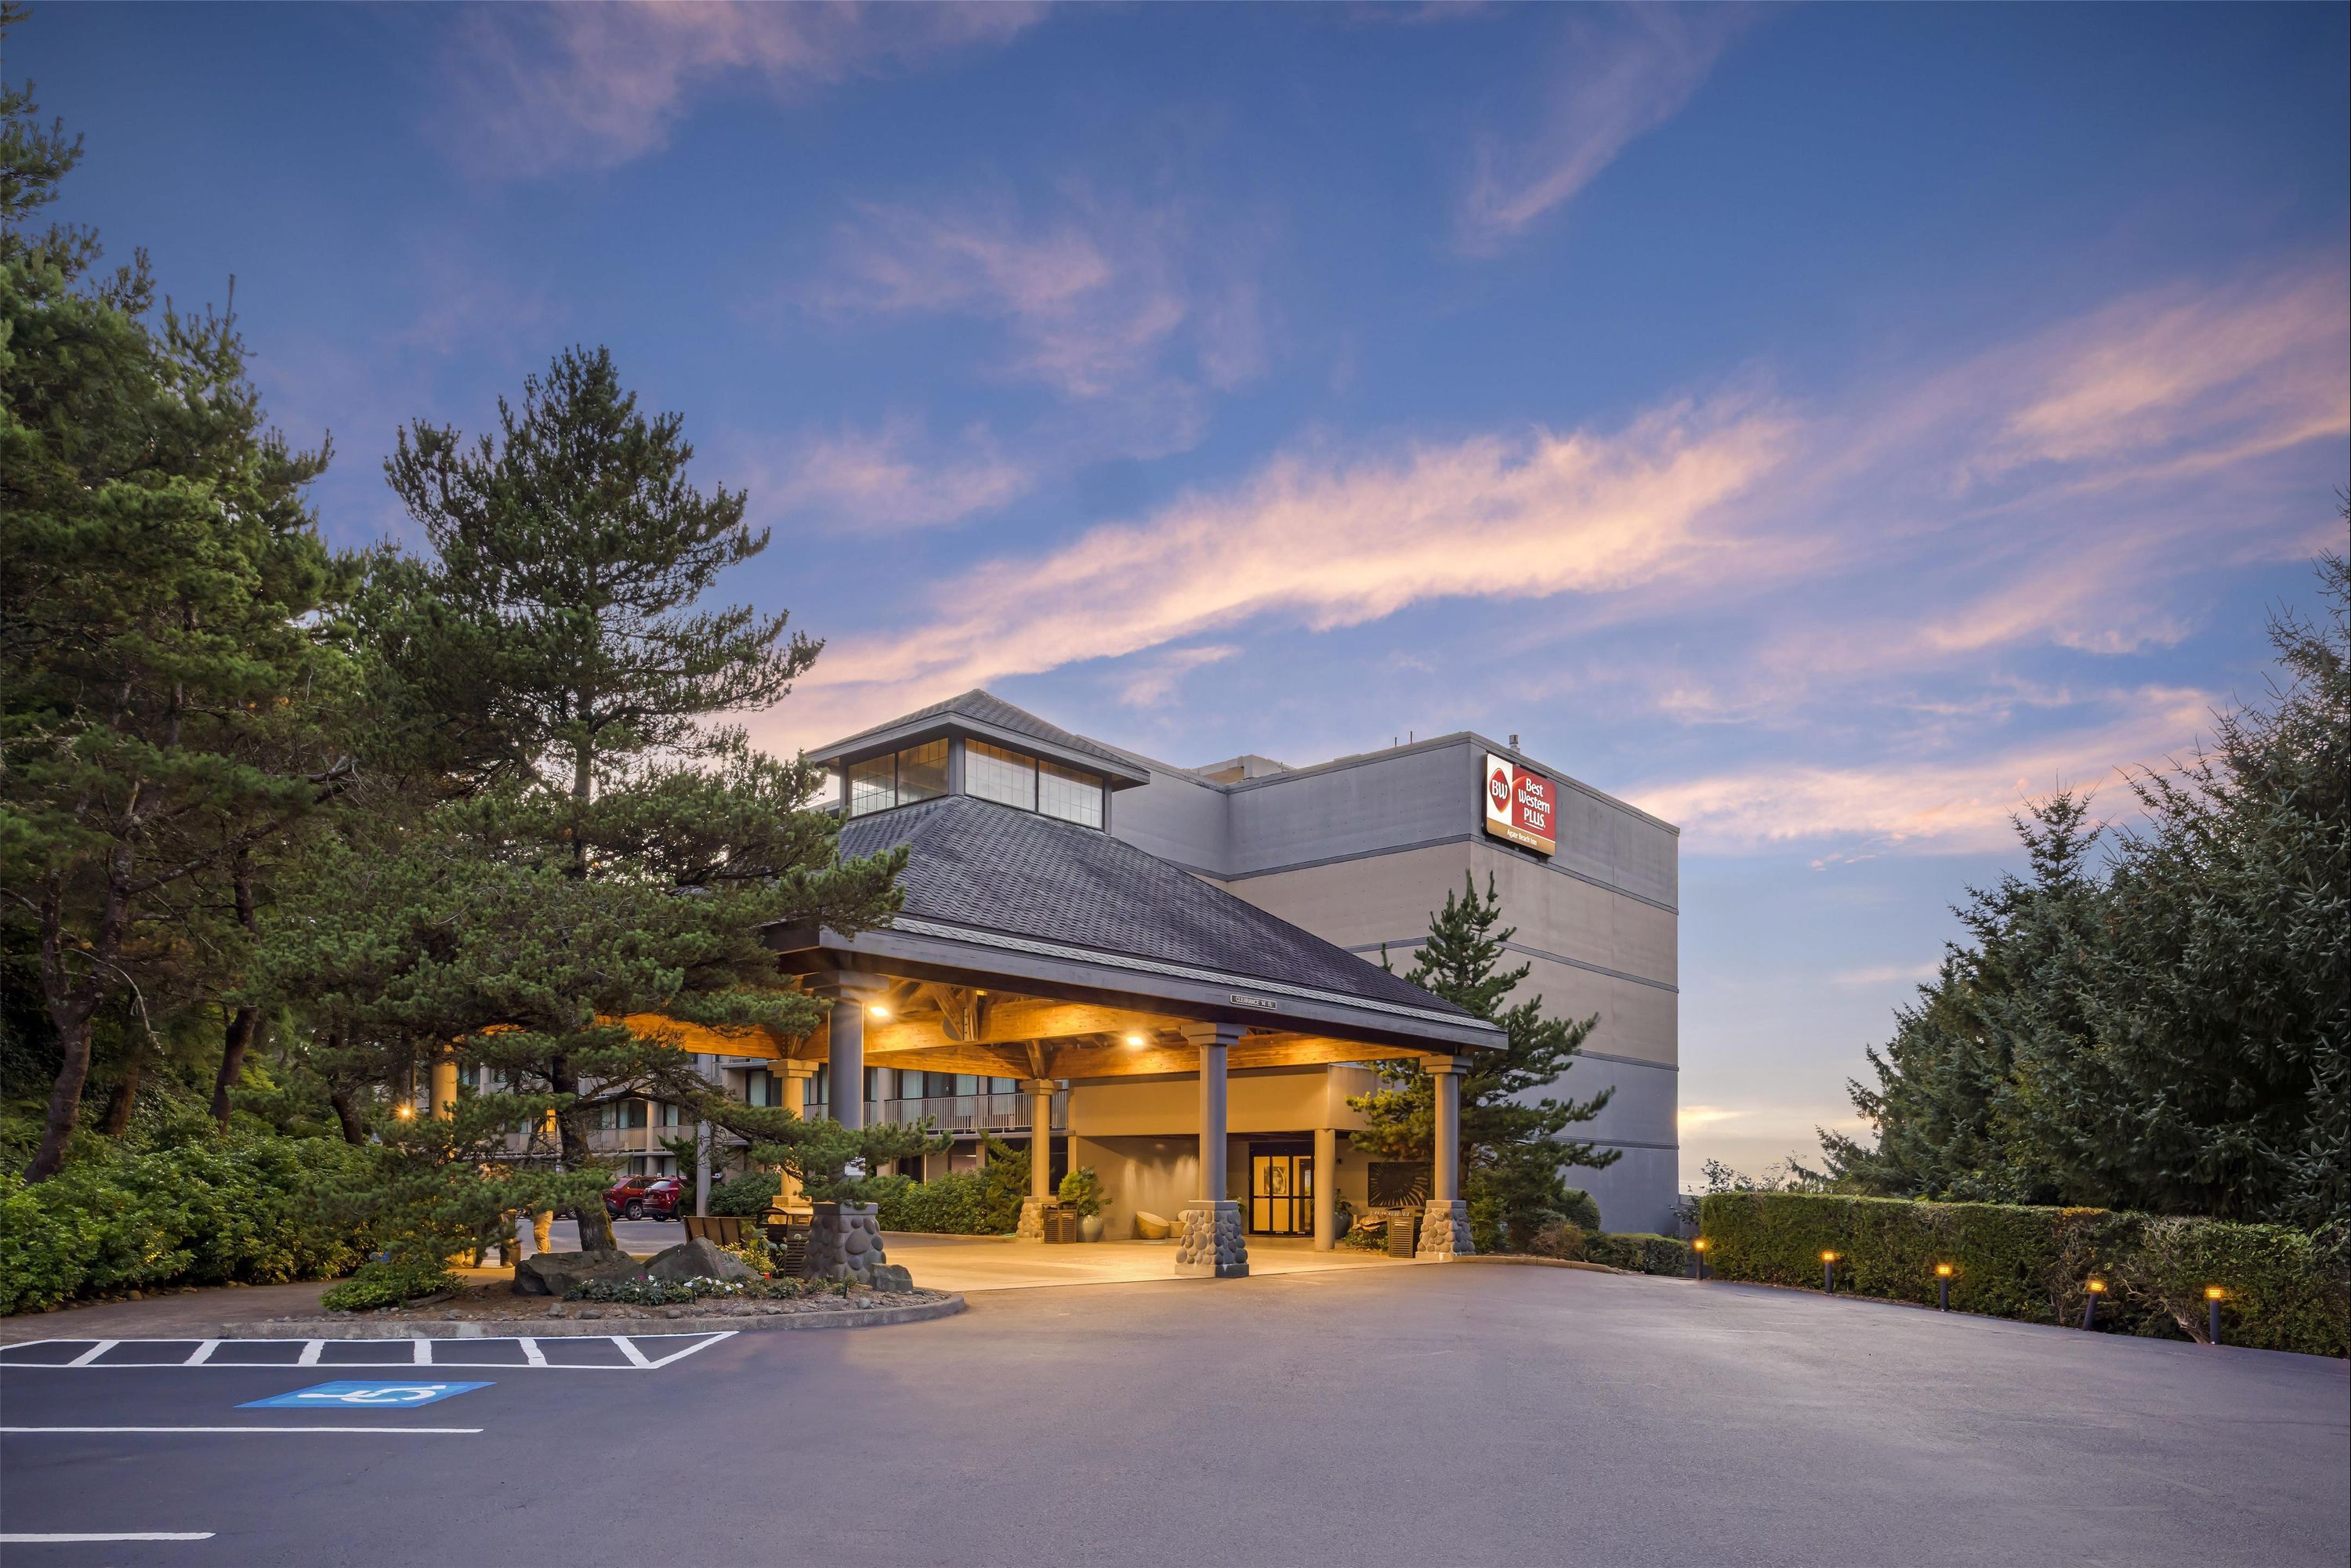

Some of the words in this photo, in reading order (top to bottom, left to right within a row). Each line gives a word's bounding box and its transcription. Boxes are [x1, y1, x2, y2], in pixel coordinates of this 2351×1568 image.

[1491, 780, 1508, 799] BW
[1526, 778, 1543, 797] Best
[1518, 788, 1550, 813] Western
[1519, 833, 1530, 843] Beach
[1235, 996, 1260, 1005] CLEARANCE
